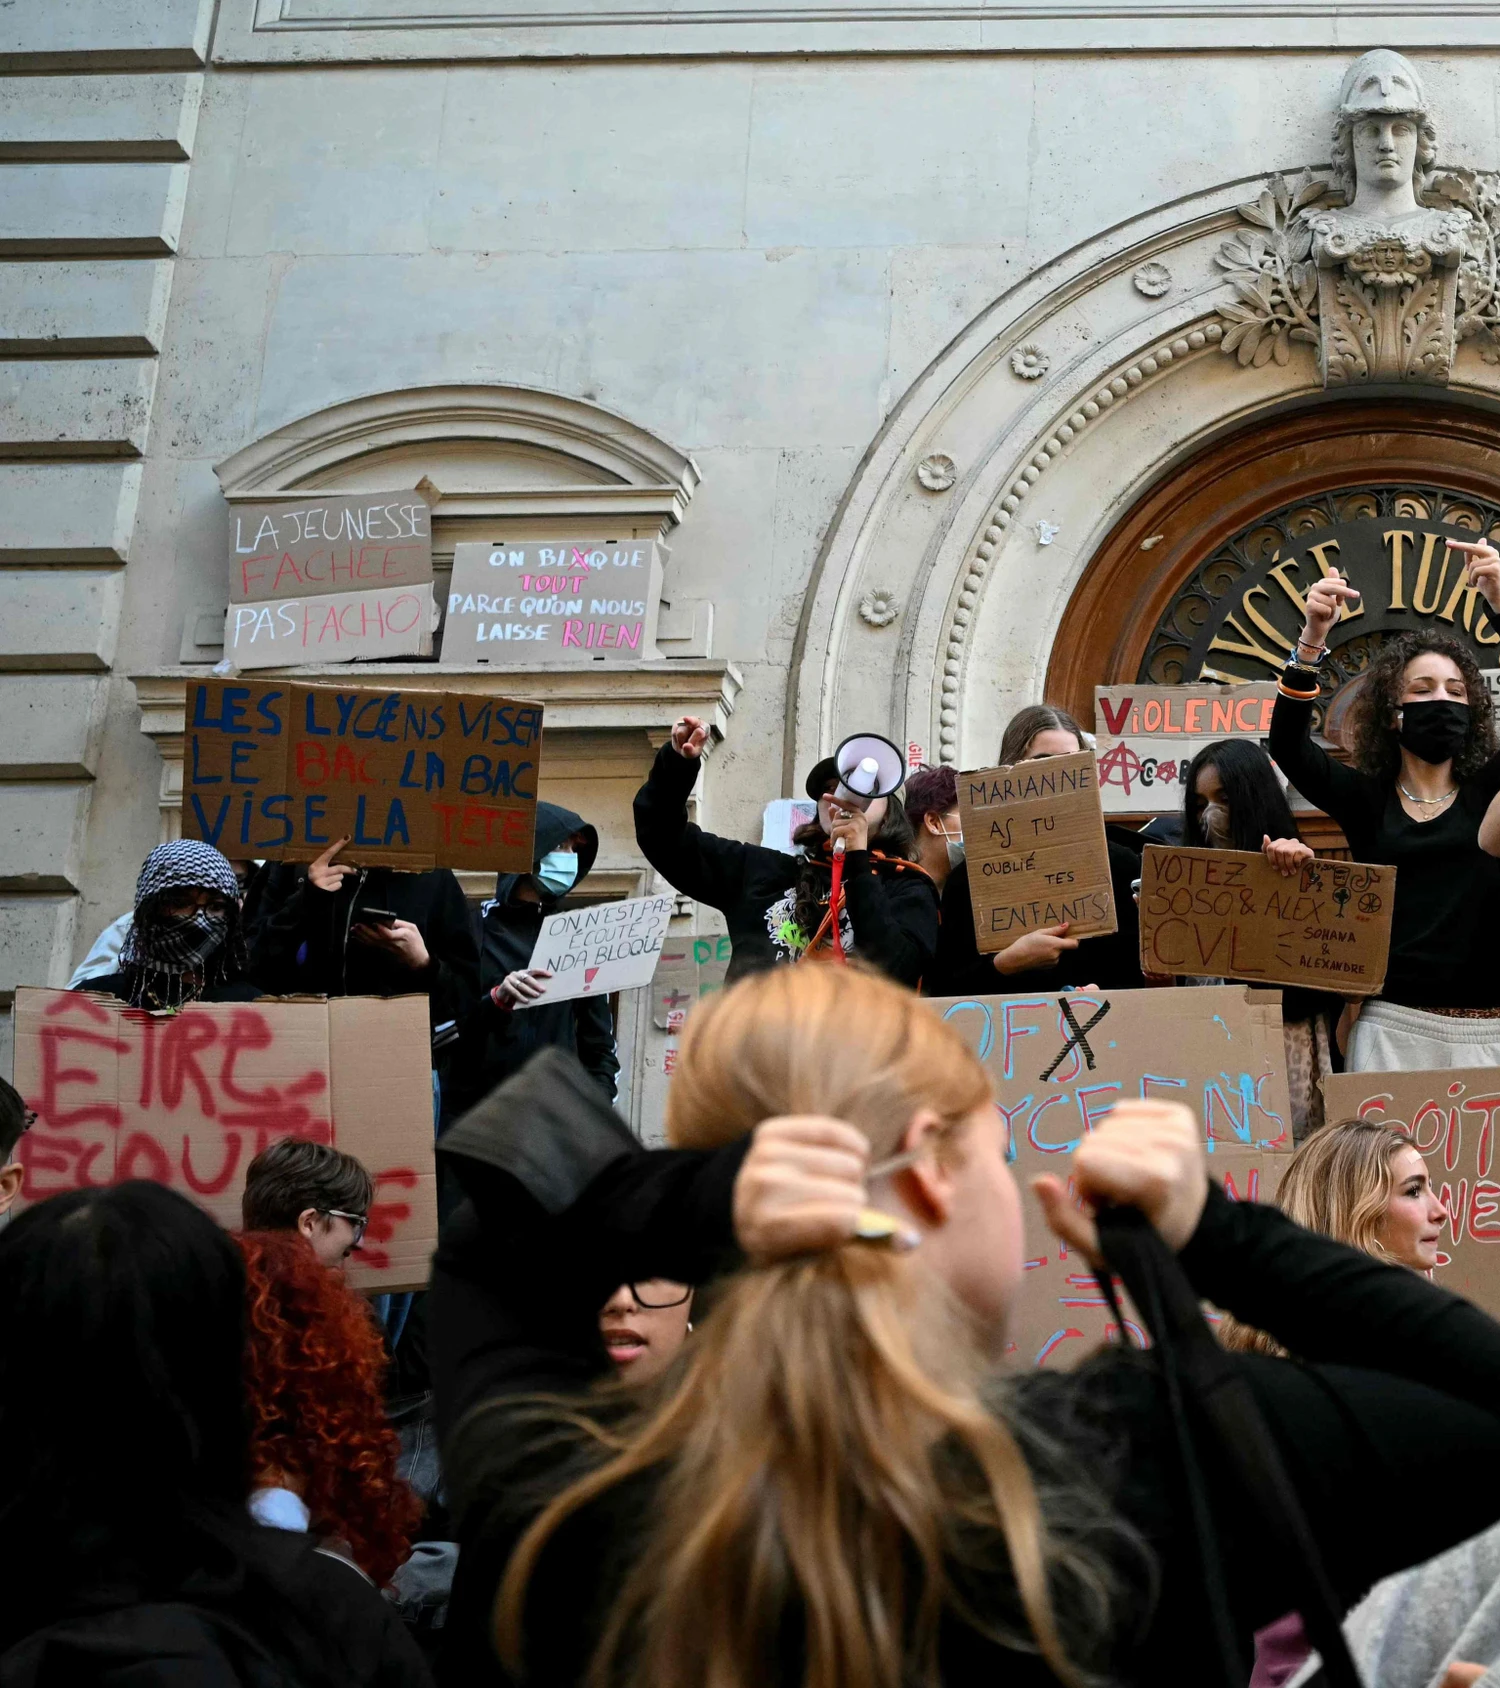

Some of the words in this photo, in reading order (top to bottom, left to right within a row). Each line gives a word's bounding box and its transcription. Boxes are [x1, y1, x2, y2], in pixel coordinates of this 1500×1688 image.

[235, 515, 280, 553] LA
[282, 503, 428, 544] JEUNESSE
[489, 551, 525, 567] ON
[518, 573, 588, 595] TOUT
[234, 602, 299, 648] PAS
[302, 594, 423, 647] FACHO
[449, 592, 517, 615] PARCE
[589, 598, 645, 616] NOUS
[476, 622, 552, 643] LAISSE
[561, 619, 644, 650] RIEN
[192, 685, 283, 736] LES
[192, 735, 260, 785] LE
[400, 750, 445, 792] LA
[459, 754, 534, 799] BAC
[908, 741, 923, 767] GILE
[969, 767, 1092, 806] MARIANNE
[354, 795, 411, 846] LA
[431, 798, 529, 848] TÊTE
[1031, 815, 1055, 837] TU
[1044, 870, 1075, 885] TES
[1151, 853, 1248, 888] VOTEZ
[549, 914, 580, 937] ON
[585, 903, 636, 928] N'EST
[641, 897, 674, 917] PAS
[1147, 886, 1234, 917] SOSO
[1239, 887, 1256, 915] &
[1264, 891, 1326, 924] ALEX
[568, 917, 643, 950] ÉCOUTÉ
[594, 930, 665, 966] BLOQUÉ
[1153, 917, 1266, 973] CVL
[1302, 926, 1356, 943] SOHANA
[1321, 944, 1330, 955] &
[1299, 956, 1366, 975] ALEXANDRE
